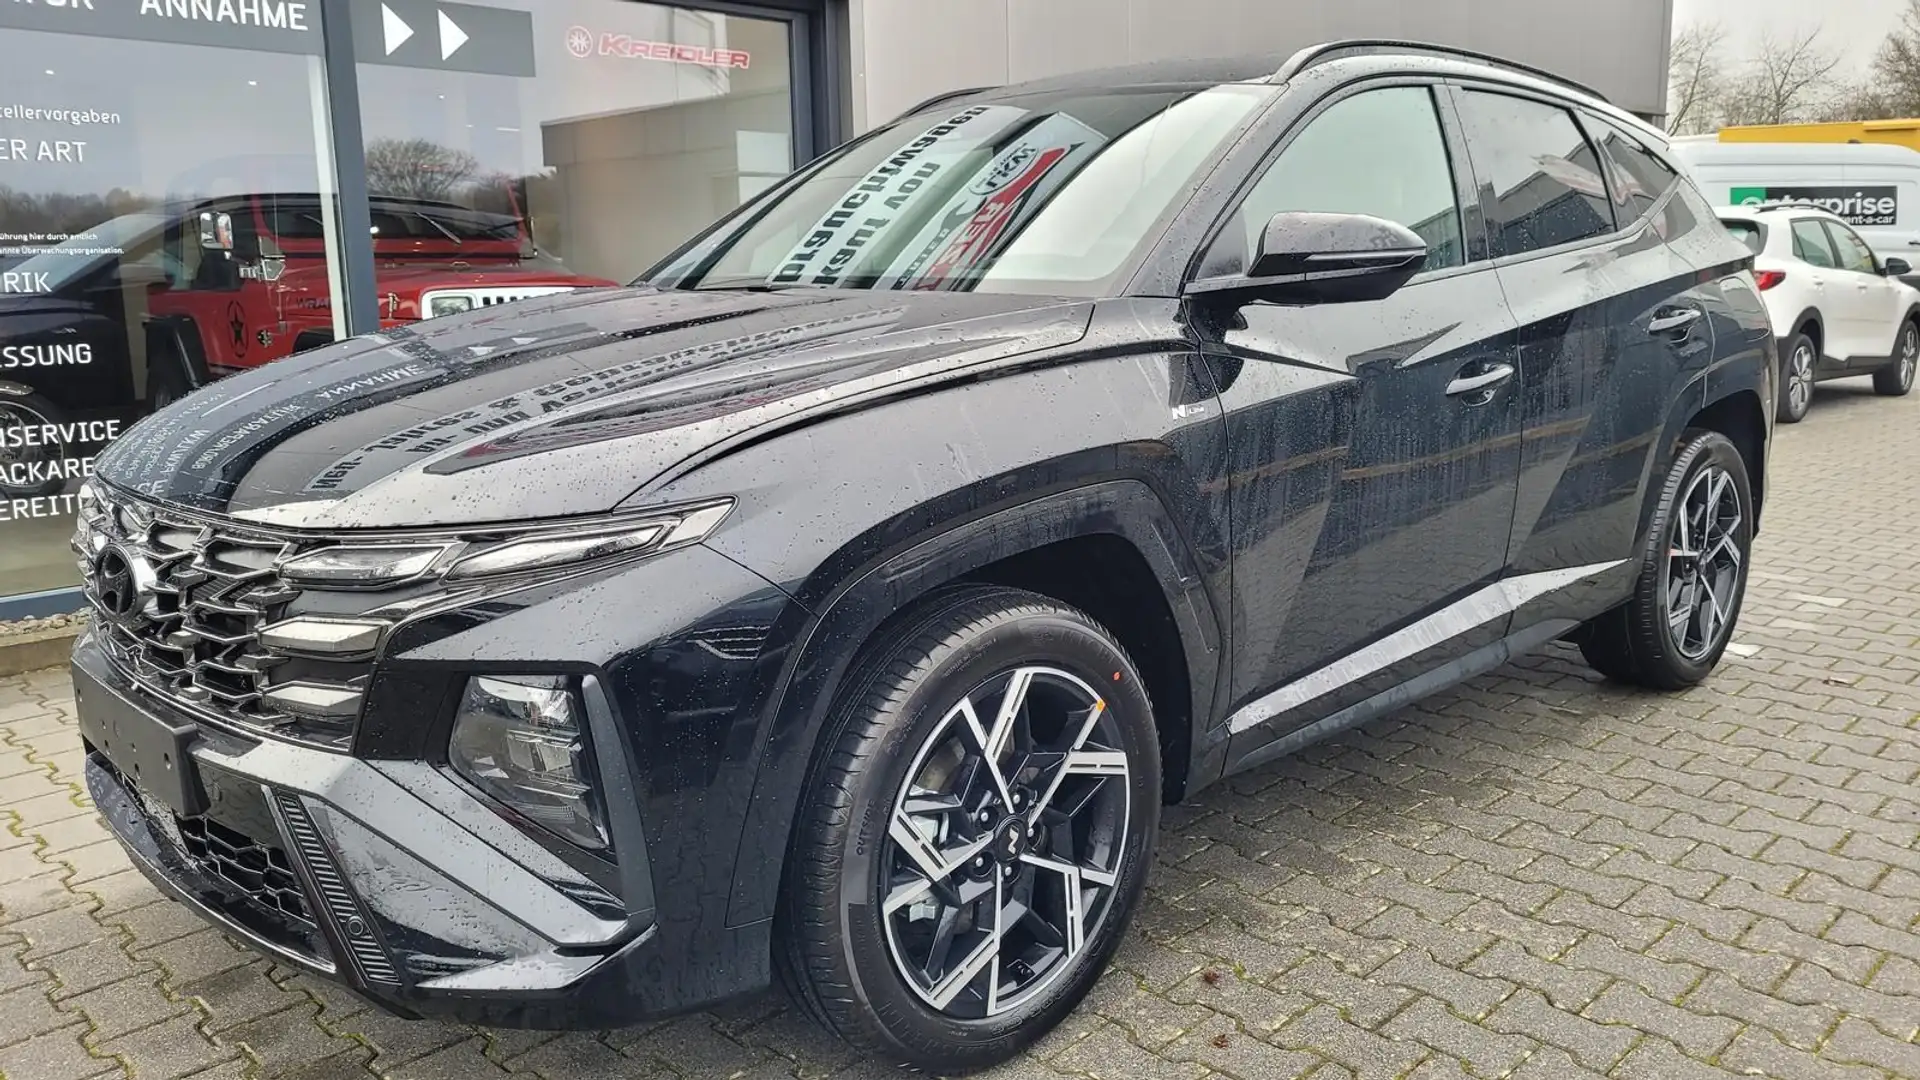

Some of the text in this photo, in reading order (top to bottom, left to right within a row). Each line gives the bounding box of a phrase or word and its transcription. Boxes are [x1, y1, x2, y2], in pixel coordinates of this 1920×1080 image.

[139, 0, 309, 31] ANNAHME
[37, 141, 87, 163] ART
[3, 271, 53, 293] RIK
[0, 342, 92, 368] SSUNG
